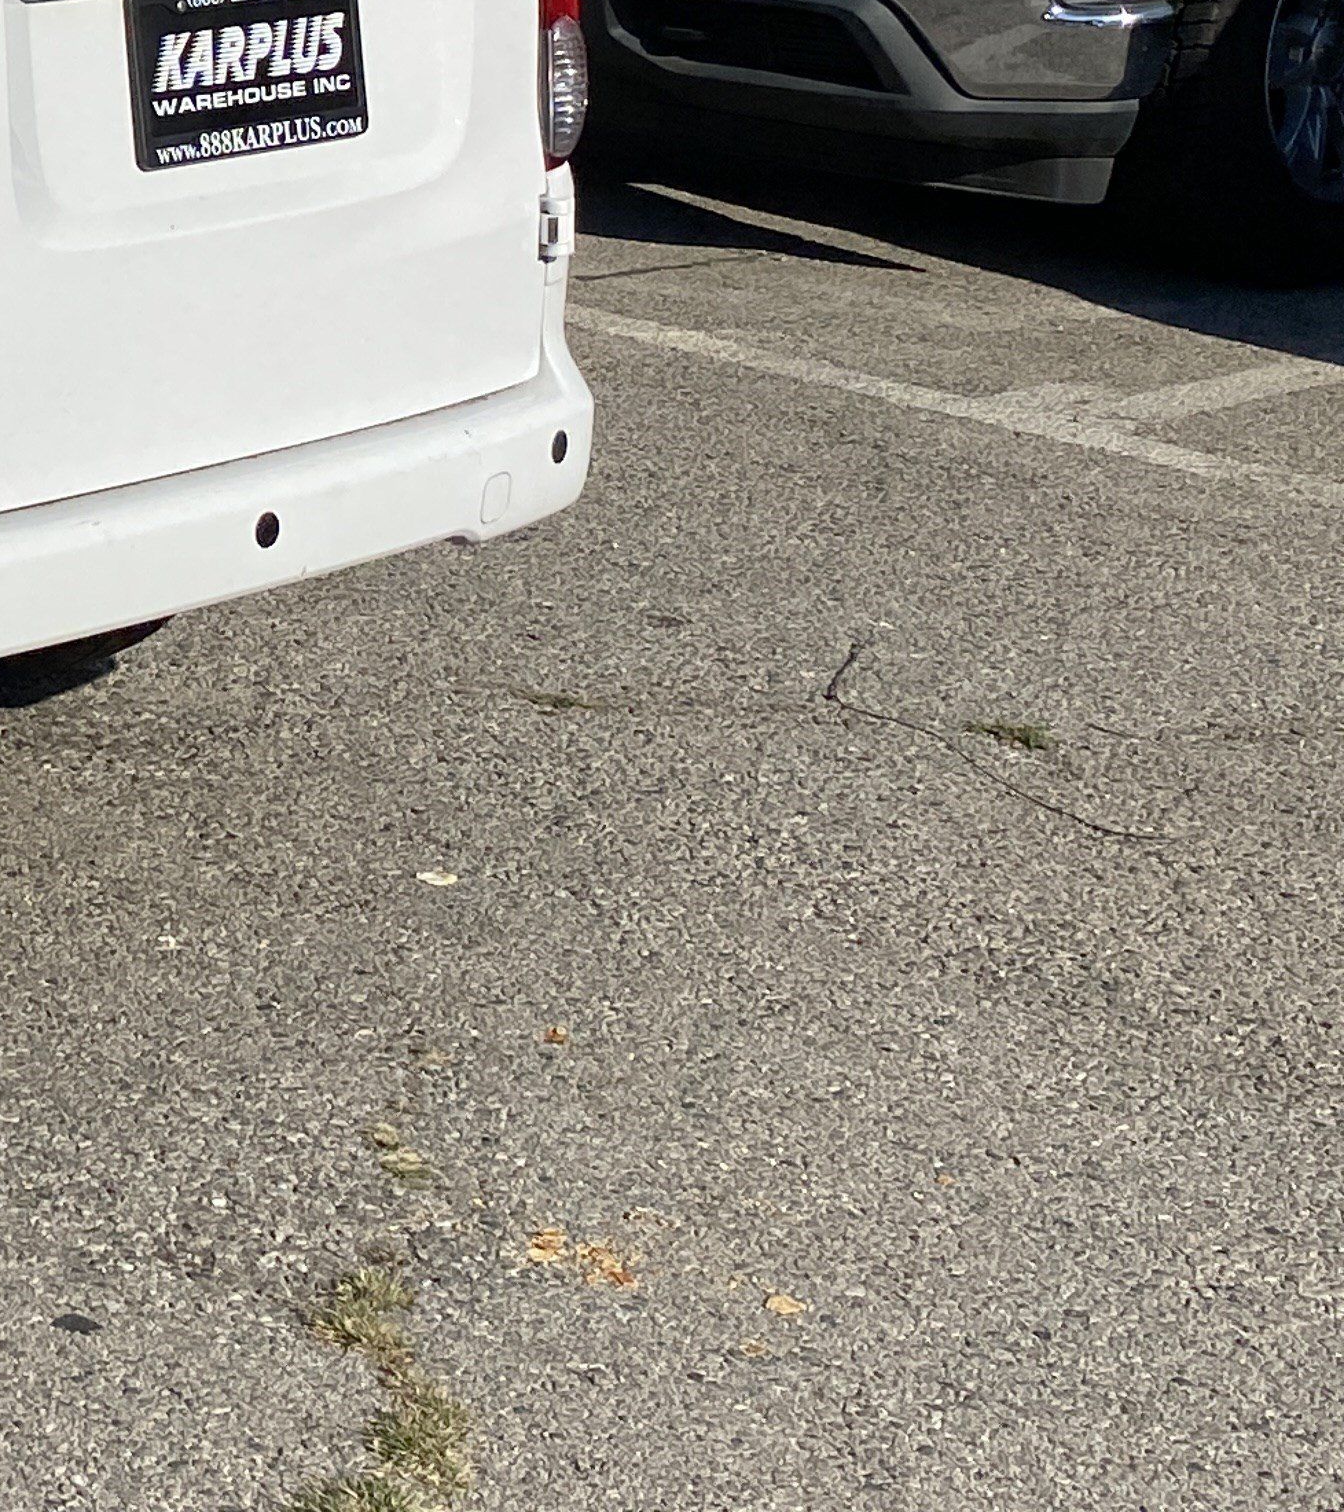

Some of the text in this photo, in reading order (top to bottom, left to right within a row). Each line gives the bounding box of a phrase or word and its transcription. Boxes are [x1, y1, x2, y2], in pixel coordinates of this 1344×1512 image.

[151, 11, 345, 93] KARPLUS
[152, 74, 352, 117] WAREHOUSE INC
